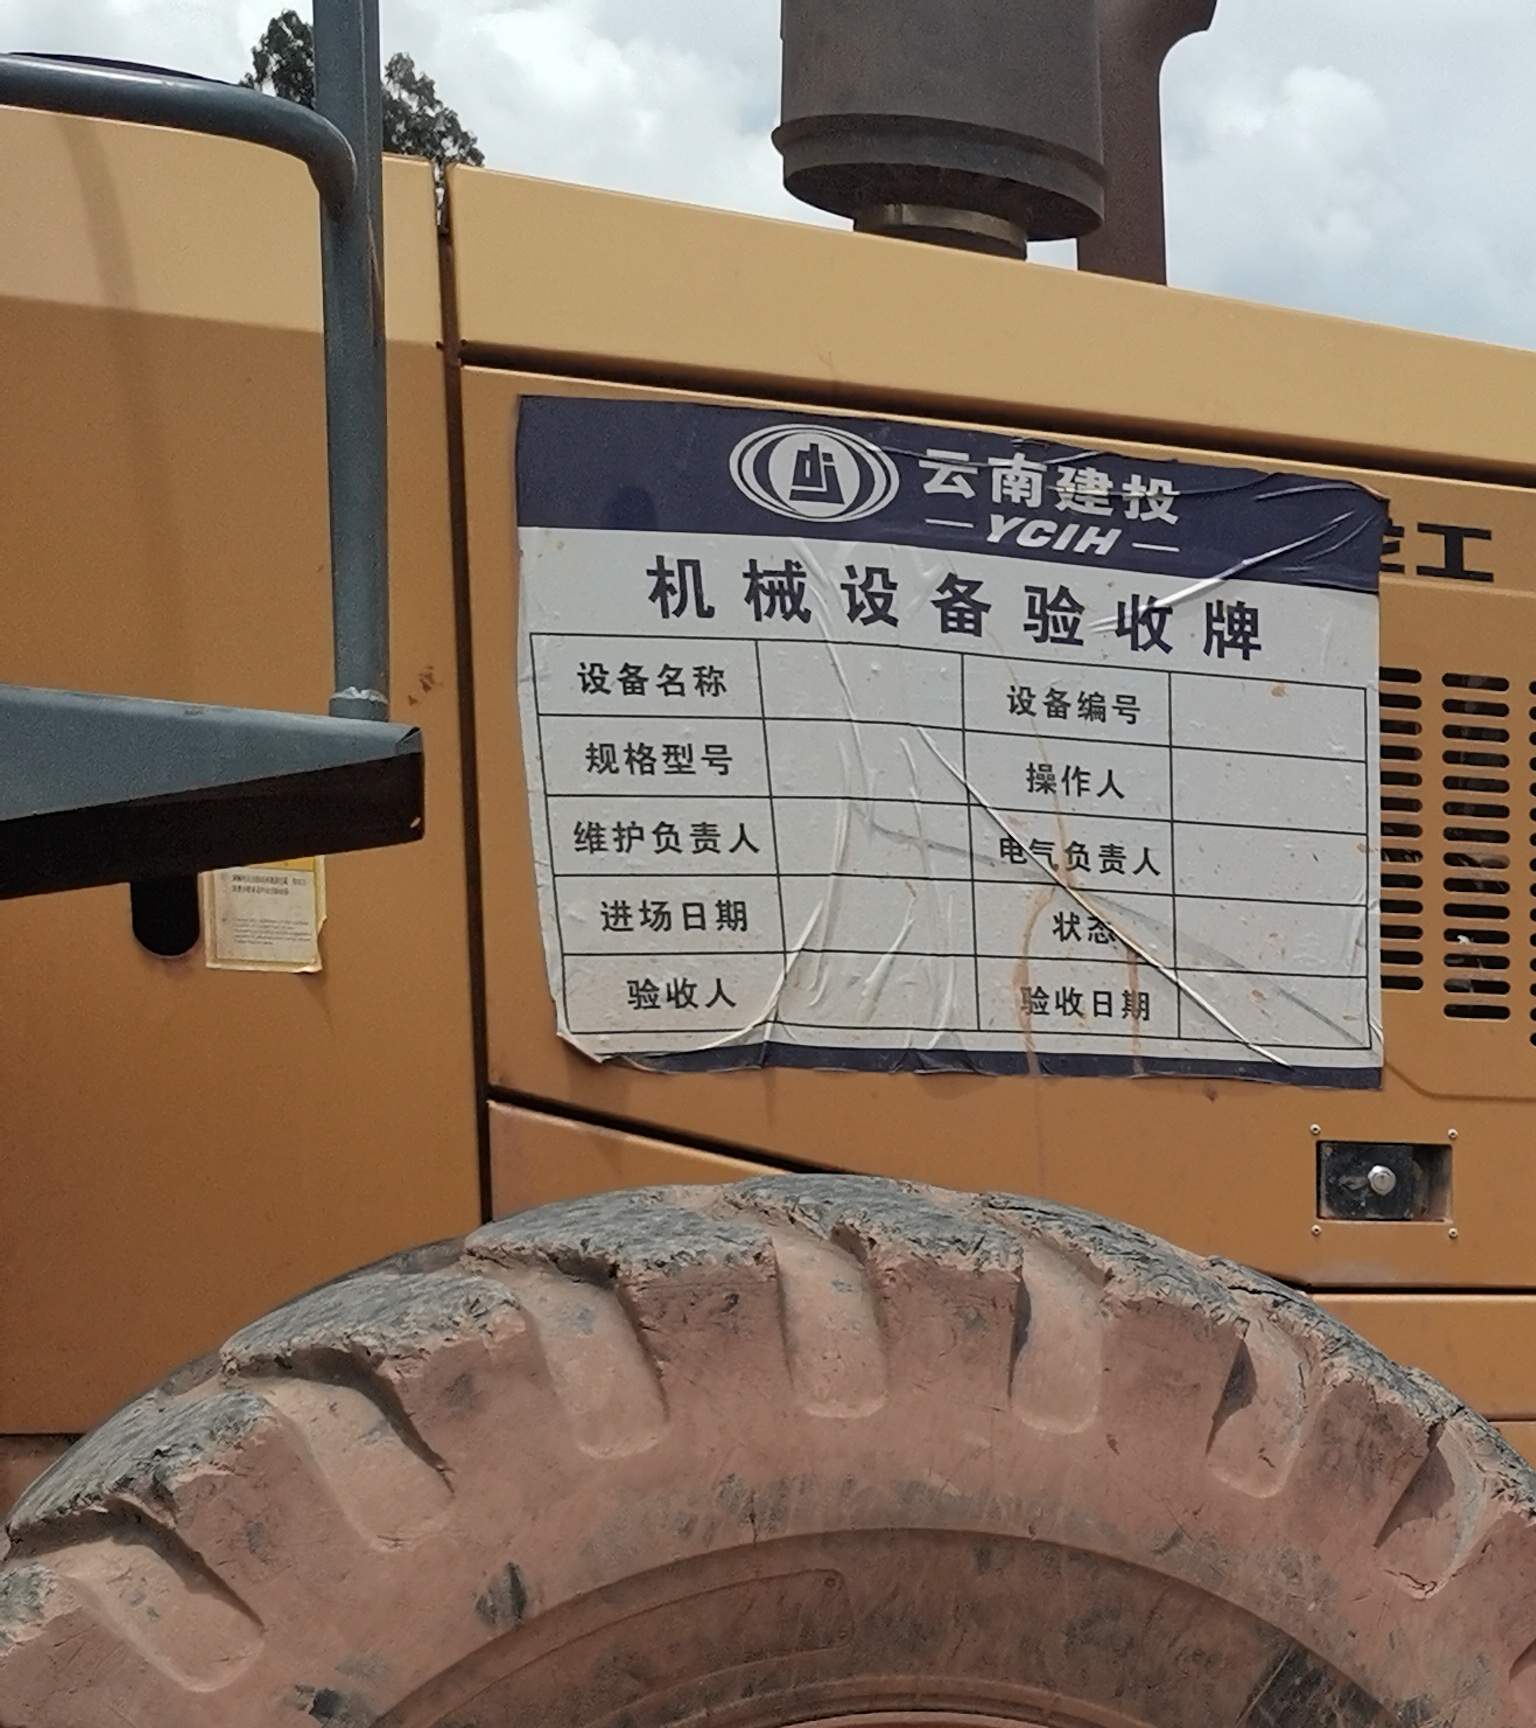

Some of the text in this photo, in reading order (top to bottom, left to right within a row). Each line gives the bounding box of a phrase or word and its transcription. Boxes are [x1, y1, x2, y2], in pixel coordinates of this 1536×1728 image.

[918, 446, 1182, 526] 云南建投
[985, 514, 1122, 558] YCIH
[1380, 522, 1494, 583] 工
[646, 555, 1263, 662] 机械设备验收牌
[576, 661, 728, 699] 设备名称
[1006, 684, 1143, 725] 设备编号
[584, 742, 734, 777] 规格型号
[1024, 761, 1126, 801] 操作人
[573, 820, 760, 857] 维护负责人
[999, 836, 1162, 878] 电气负责人
[600, 898, 749, 934] 进场日期
[1053, 911, 1117, 947] 状态
[627, 977, 737, 1012] 验收人
[1020, 985, 1152, 1024] 验收日期
